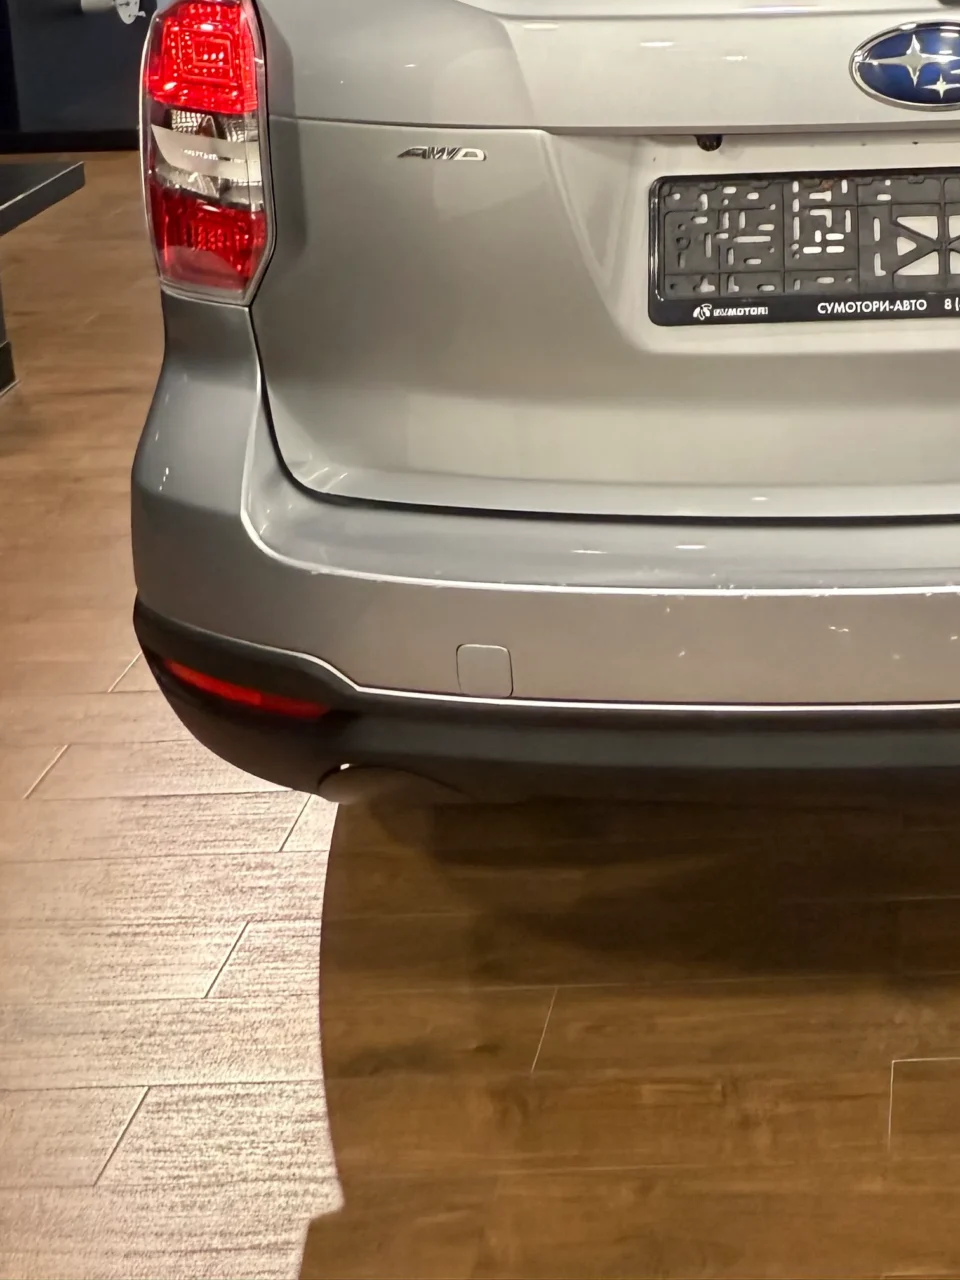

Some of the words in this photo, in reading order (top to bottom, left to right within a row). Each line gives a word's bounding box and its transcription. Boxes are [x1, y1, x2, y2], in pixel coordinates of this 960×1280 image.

[397, 146, 487, 161] AWD
[817, 299, 928, 314] СУМОТОРИ-АВТО
[944, 298, 952, 310] 8
